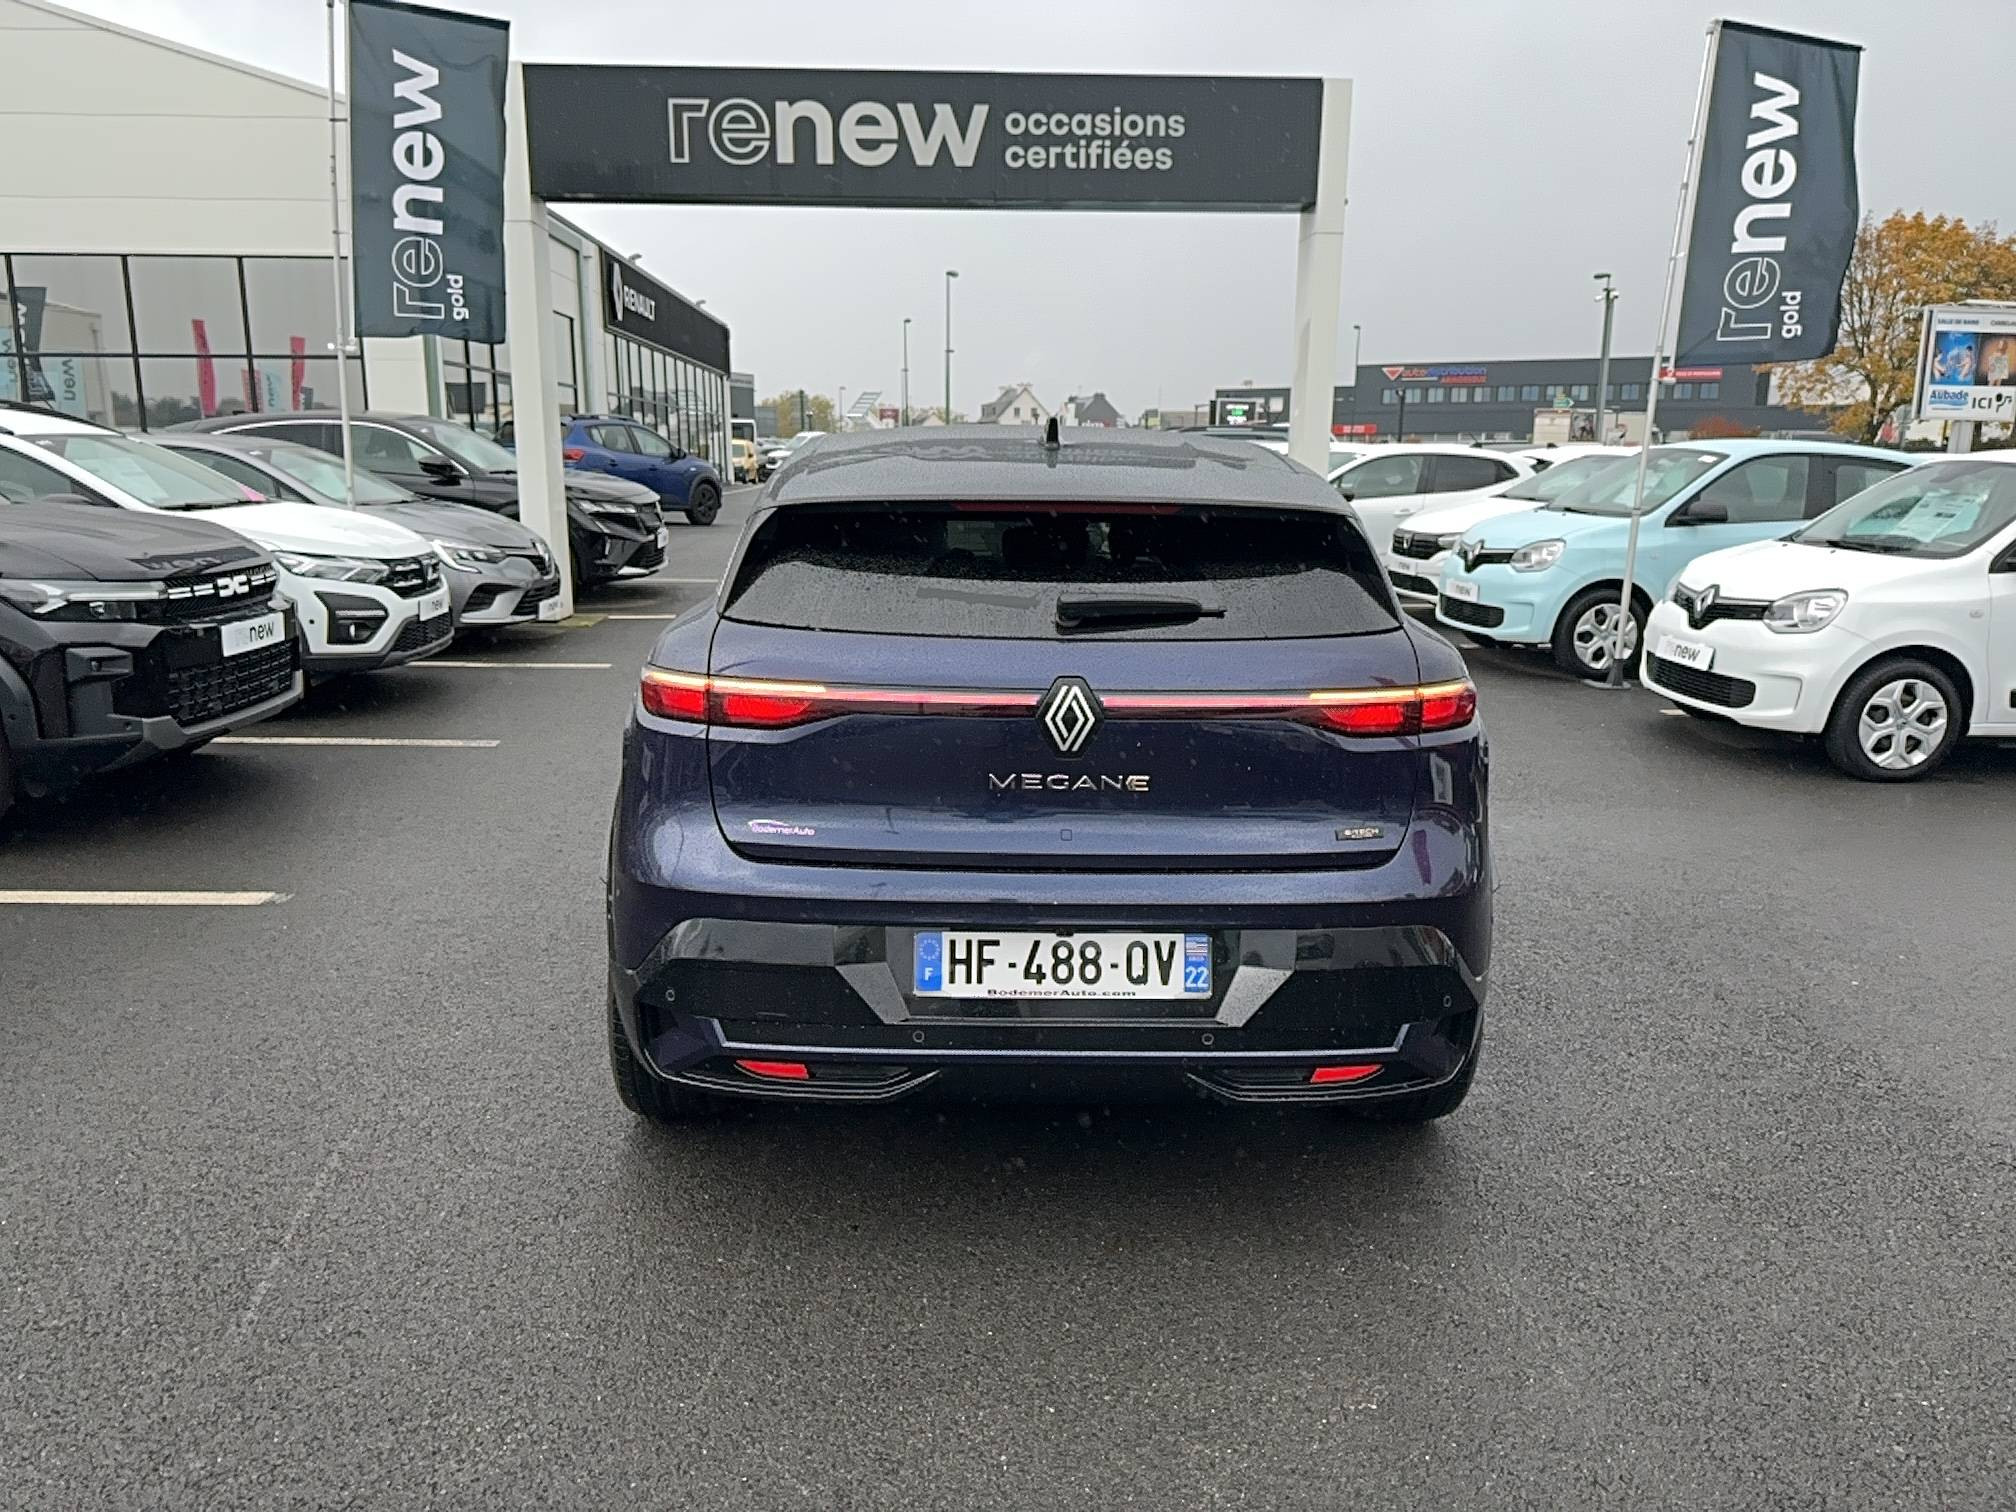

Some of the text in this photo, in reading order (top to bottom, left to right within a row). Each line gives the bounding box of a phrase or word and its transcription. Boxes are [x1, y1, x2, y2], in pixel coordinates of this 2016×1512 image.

[667, 98, 990, 168] renew
[1004, 106, 1186, 137] occasions
[1004, 139, 1174, 170] certifiées
[392, 49, 445, 320] renew
[1716, 71, 1800, 341] renew
[446, 274, 469, 321] gold
[1780, 291, 1802, 339] gold
[1930, 390, 1969, 401] Aubade
[1972, 396, 1993, 410] ICI
[988, 773, 1151, 791] MEGANE
[924, 967, 933, 981] F
[948, 938, 1177, 986] HF-488-QV
[1185, 965, 1209, 988] 22
[987, 988, 1137, 997] BodemerAuto.com
